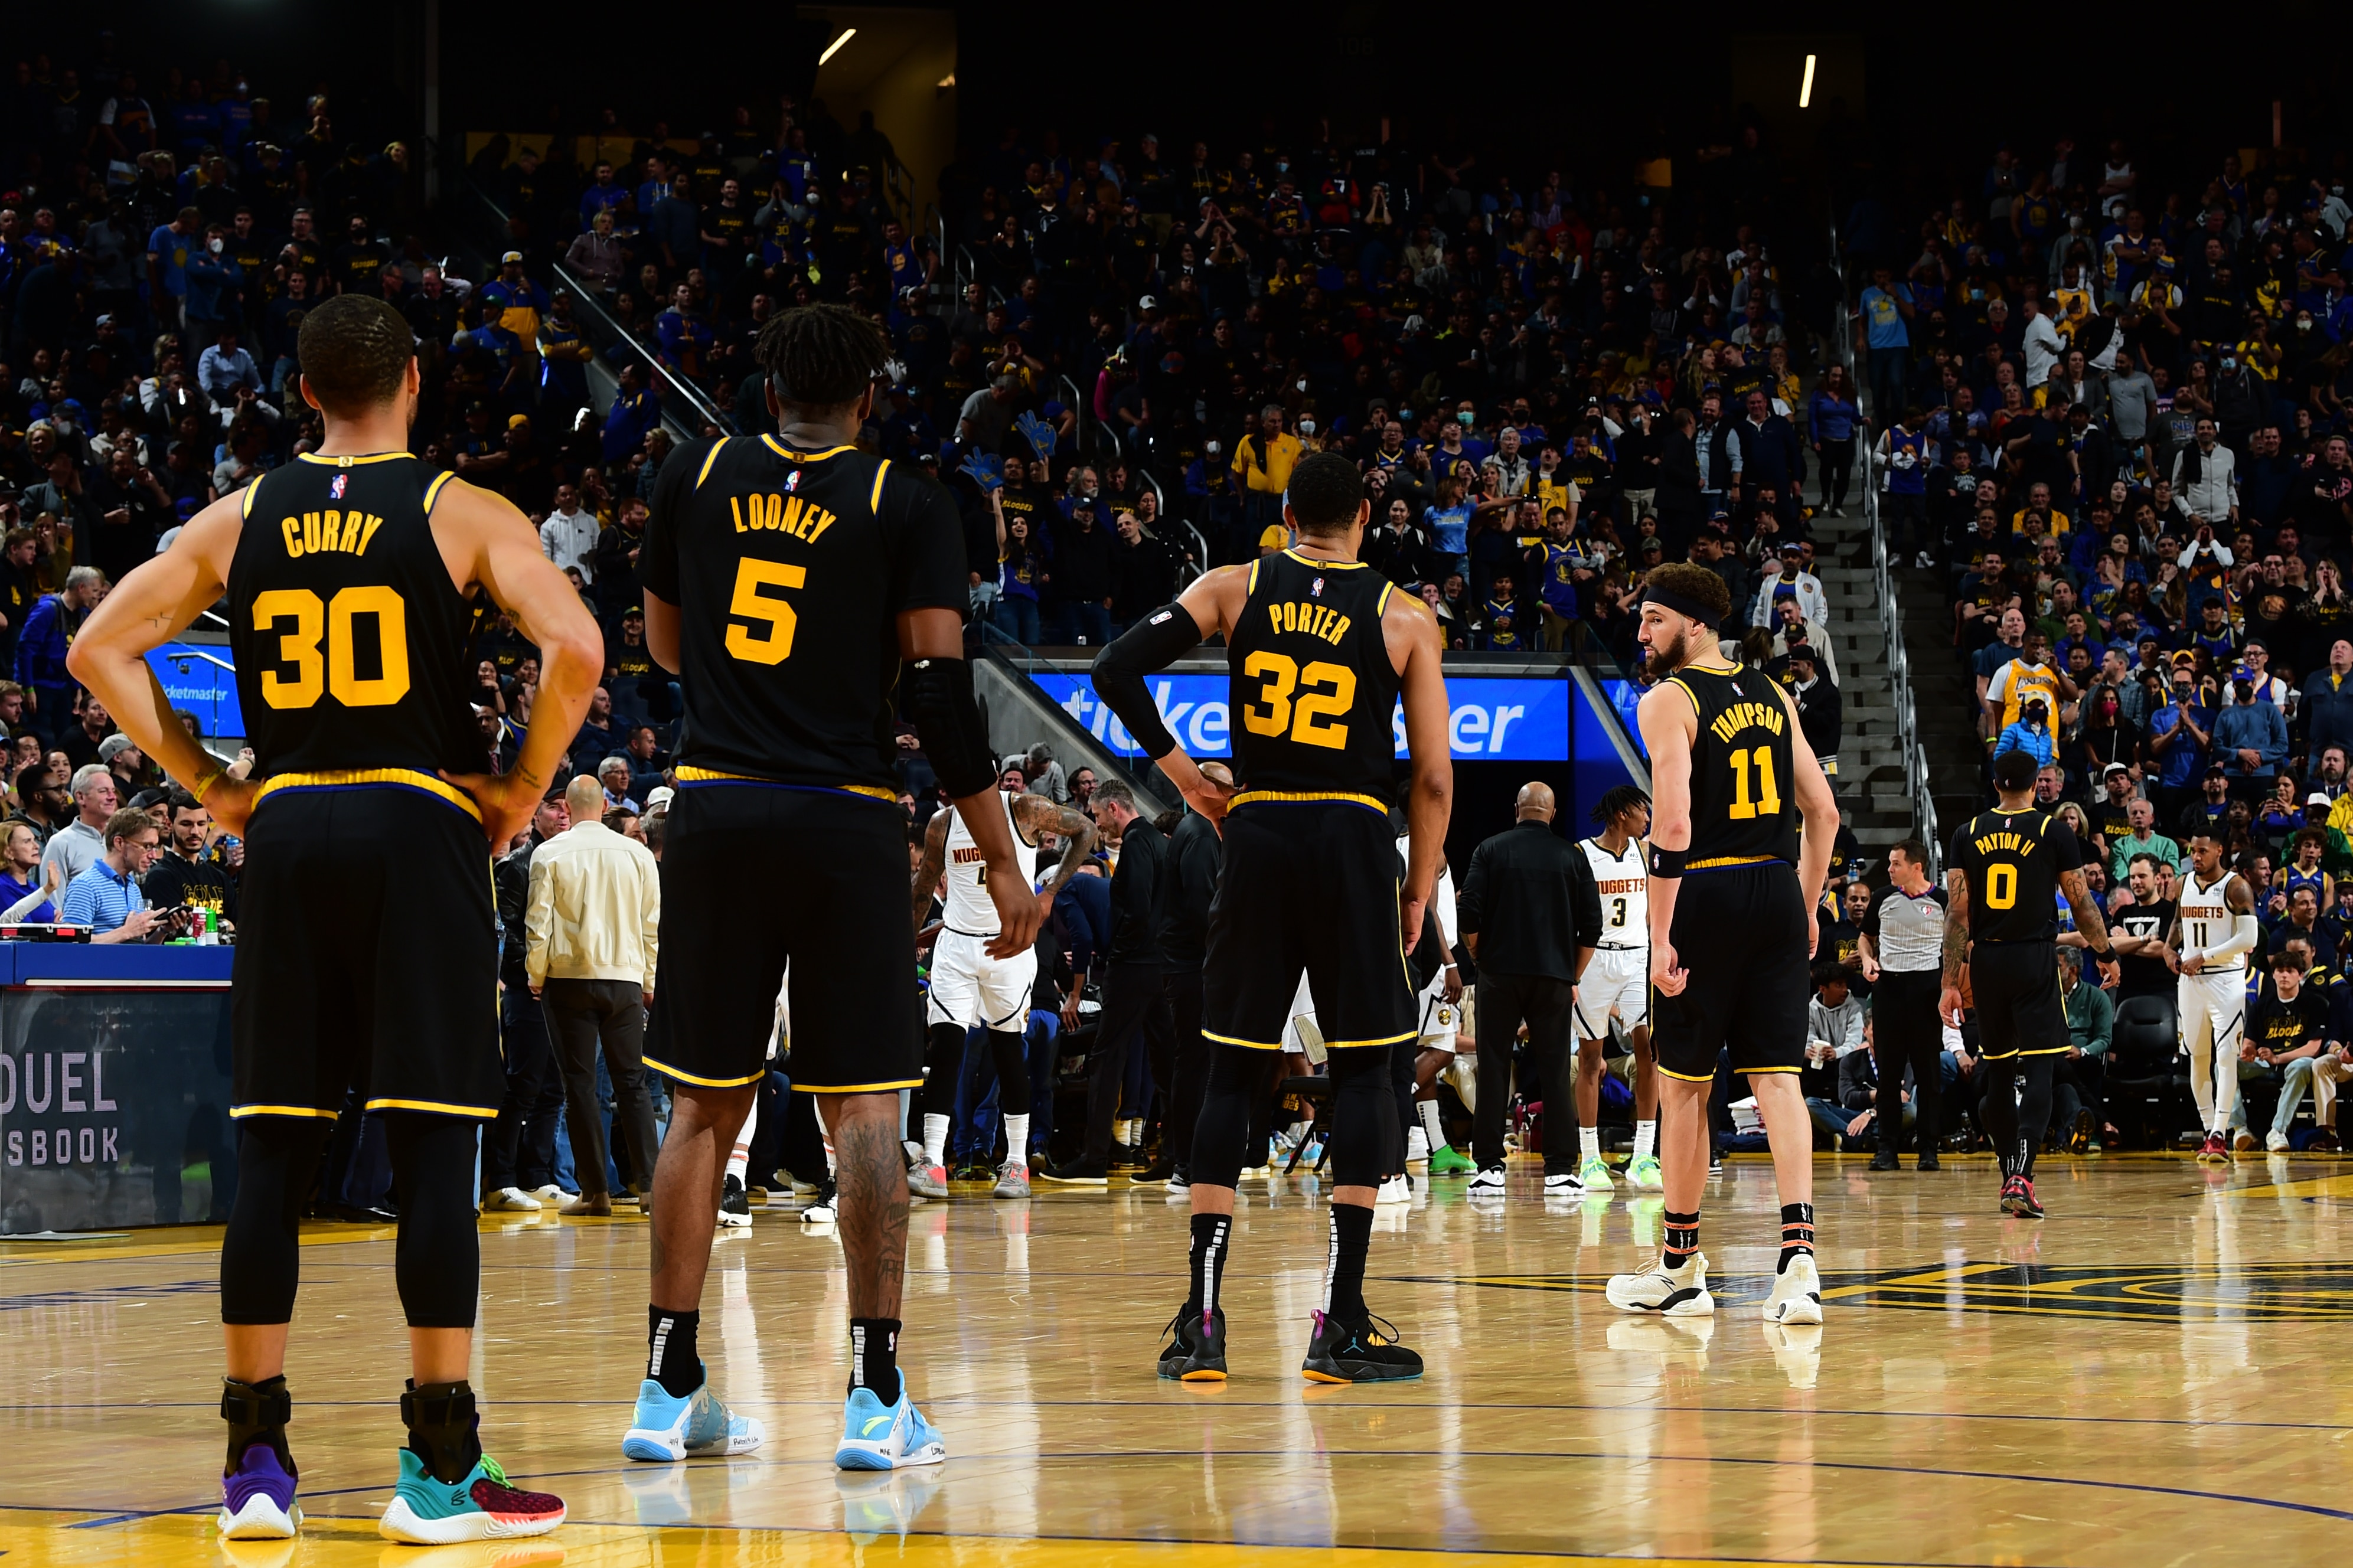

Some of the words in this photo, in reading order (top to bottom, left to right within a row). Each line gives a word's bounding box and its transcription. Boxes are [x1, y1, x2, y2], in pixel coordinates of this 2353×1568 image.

[775, 224, 789, 236] 30
[282, 510, 383, 558] CURRY
[730, 494, 836, 544] LOONEY
[725, 556, 807, 665] 5
[1268, 602, 1351, 646] PORTER
[252, 586, 410, 709] 30
[162, 684, 229, 701] icketmaster
[1244, 650, 1357, 750] 32
[1711, 703, 1783, 743] THOMPSON
[1729, 746, 1781, 819] 11
[1975, 832, 2021, 855] PAYTON
[2020, 839, 2035, 857] II
[1986, 863, 2017, 910] 0
[1611, 897, 1627, 927] 3
[2192, 922, 2207, 948] 11
[8, 1127, 118, 1167] SBOOK
